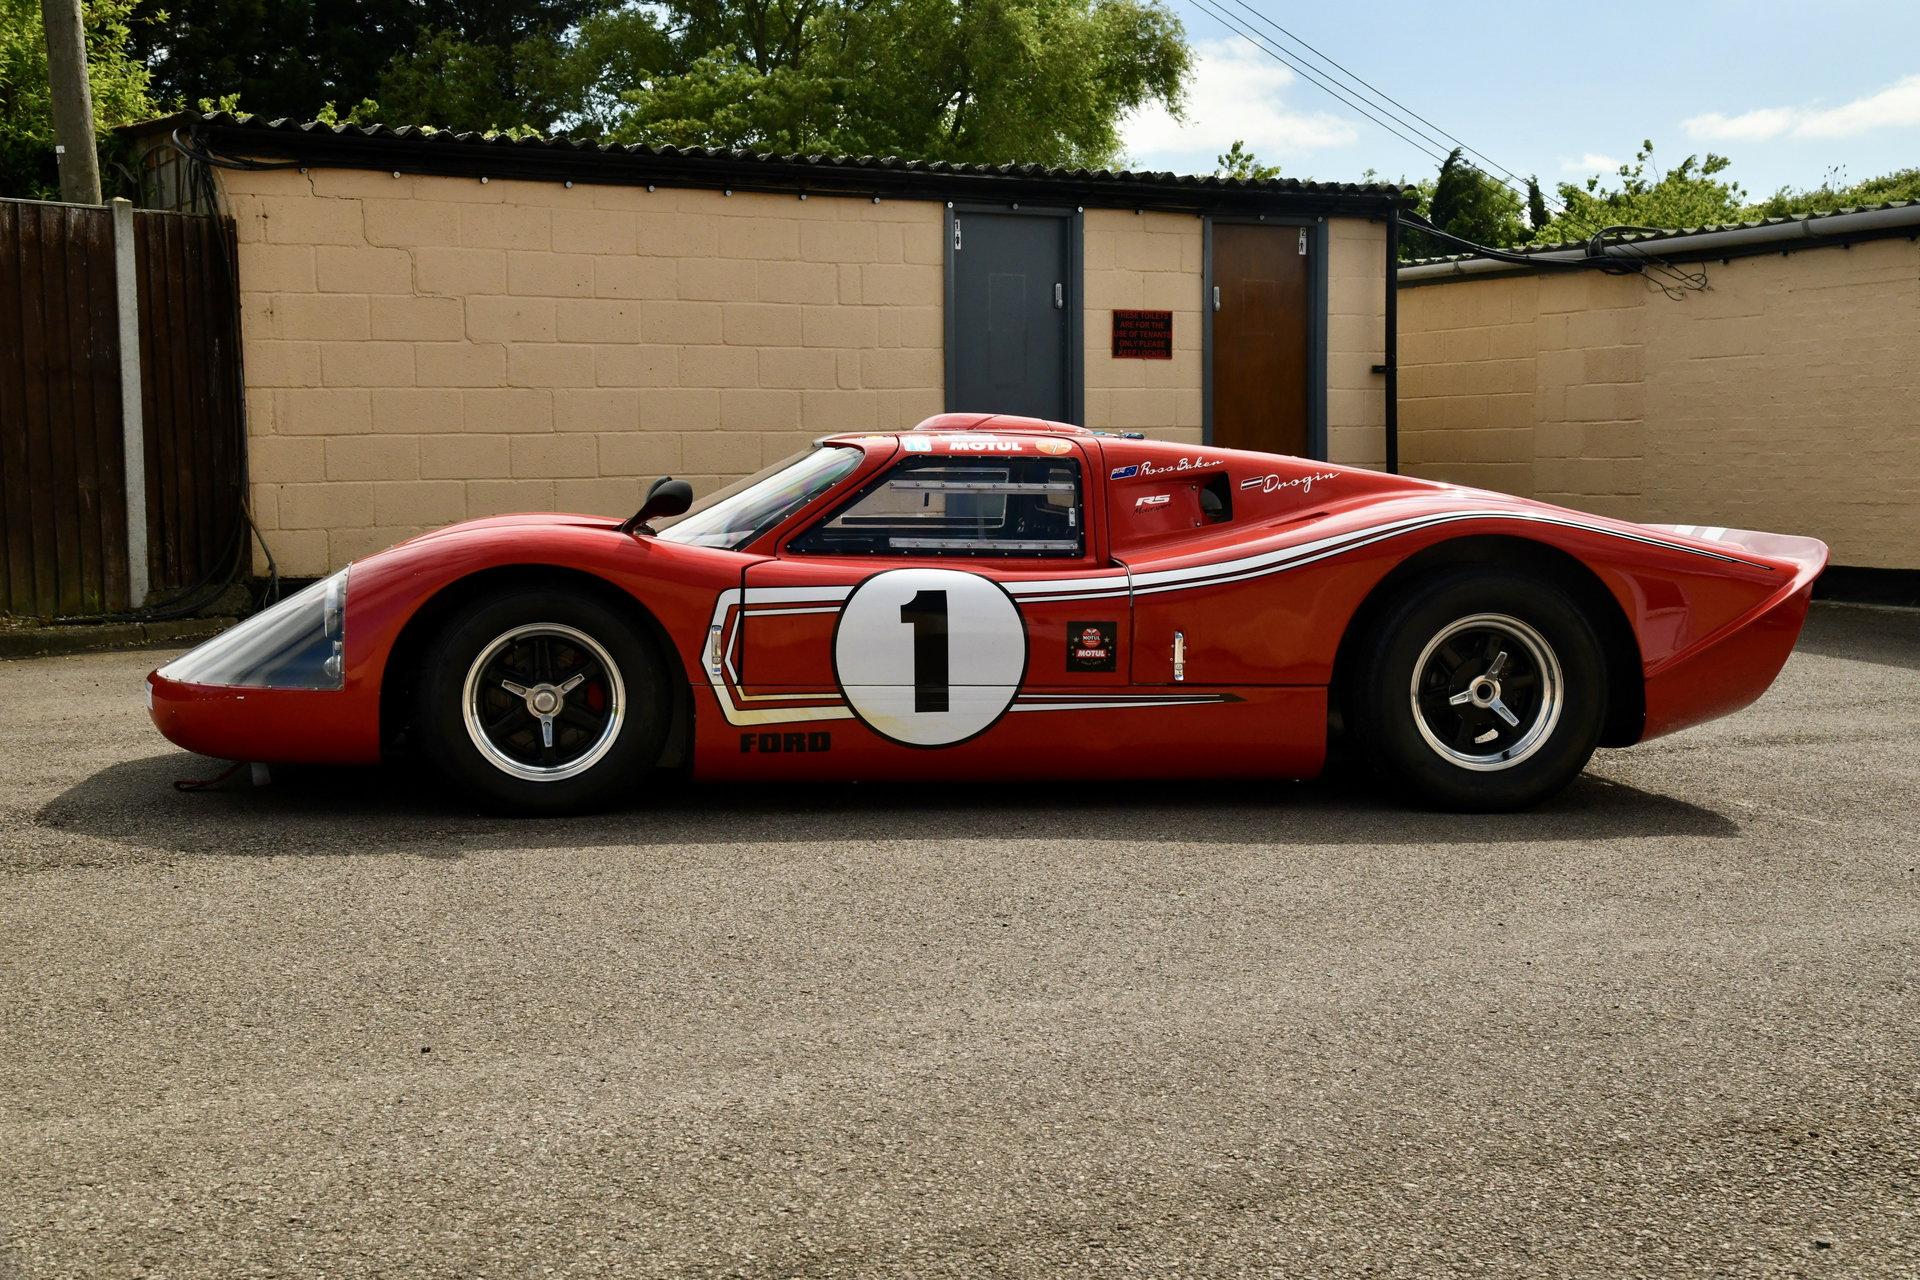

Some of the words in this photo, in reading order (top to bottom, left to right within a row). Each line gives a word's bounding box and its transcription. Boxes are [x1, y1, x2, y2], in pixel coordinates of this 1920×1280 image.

[1138, 349, 1166, 357] LOCKED
[949, 441, 1022, 451] MOTUL
[1140, 461, 1176, 476] Ross
[1135, 494, 1171, 506] RS
[900, 590, 949, 712] 1
[740, 732, 831, 753] FORD
